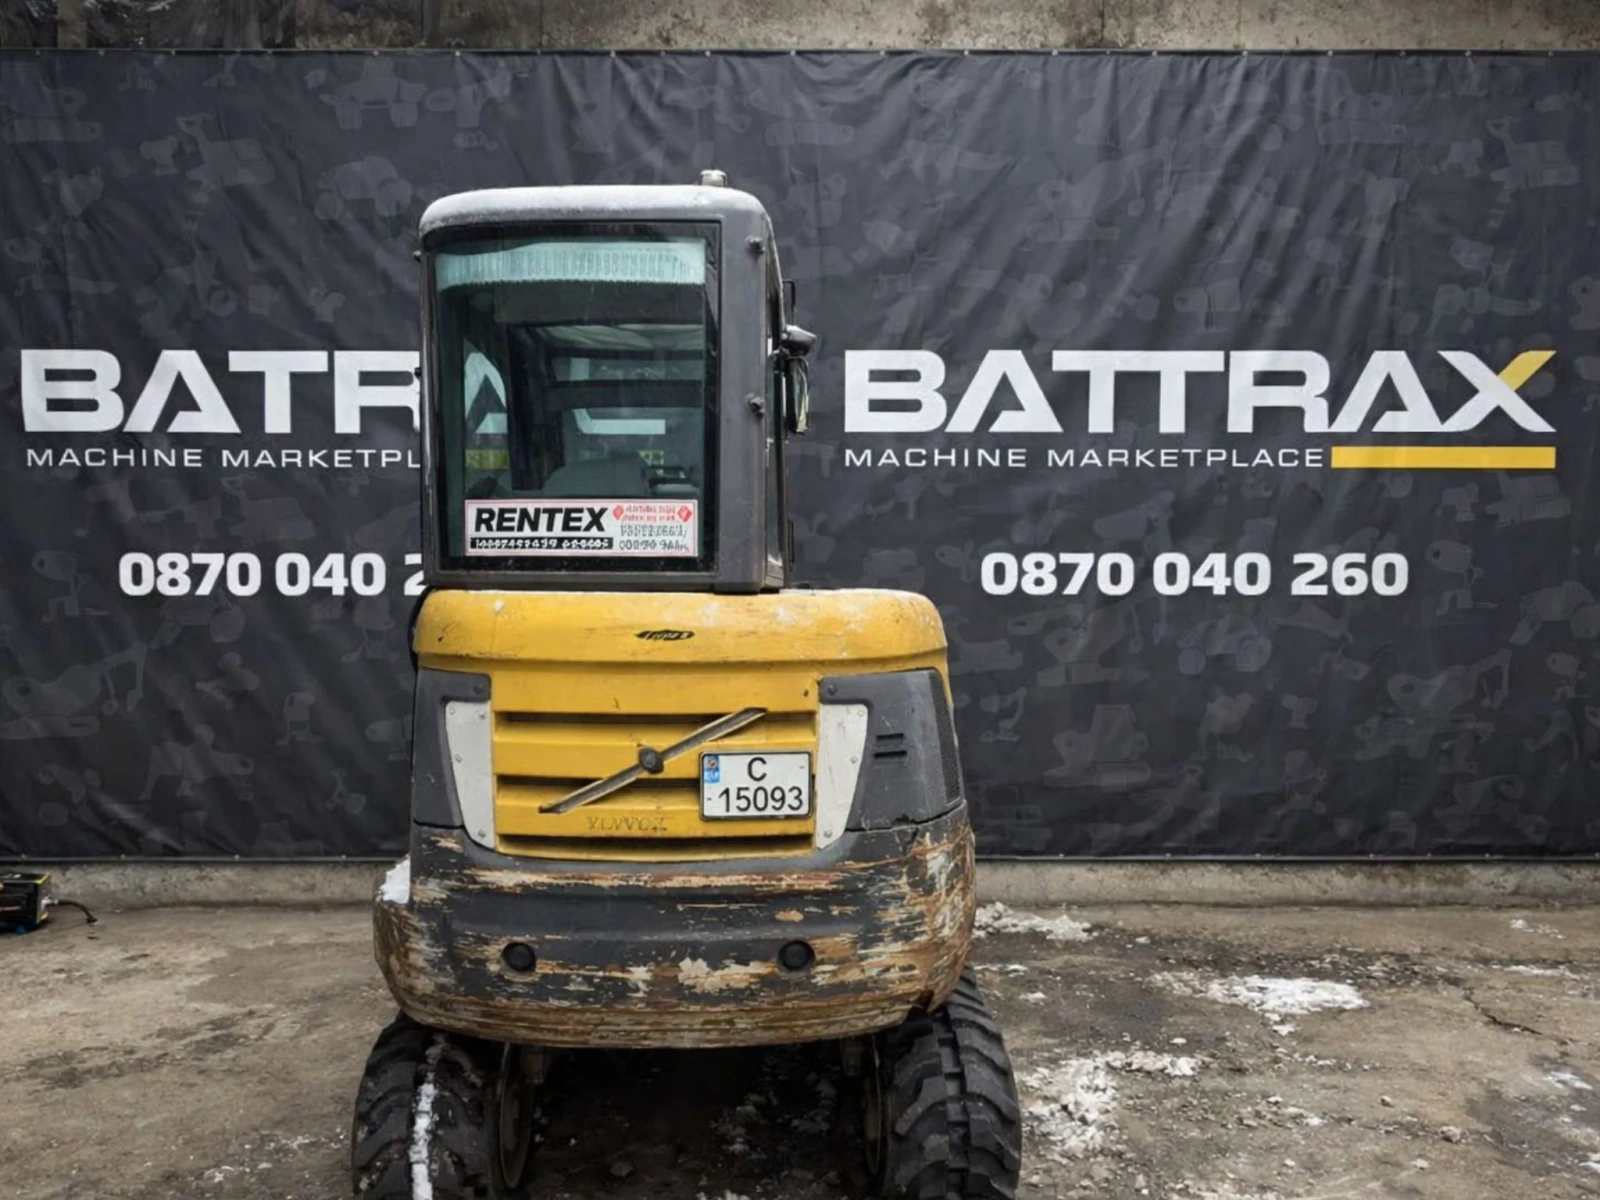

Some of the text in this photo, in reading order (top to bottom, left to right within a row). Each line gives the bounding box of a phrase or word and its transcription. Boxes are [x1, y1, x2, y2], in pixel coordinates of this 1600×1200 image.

[844, 349, 1556, 434] BATTRAX
[26, 448, 202, 468] MACHINE
[844, 447, 1324, 468] MACHINE MARKETPLACE
[474, 507, 609, 532] RENTEX
[119, 552, 262, 597] 0870
[275, 552, 387, 597] 040
[980, 552, 1409, 596] 0870 040 260
[747, 756, 767, 782] C
[718, 785, 804, 812] 15093
